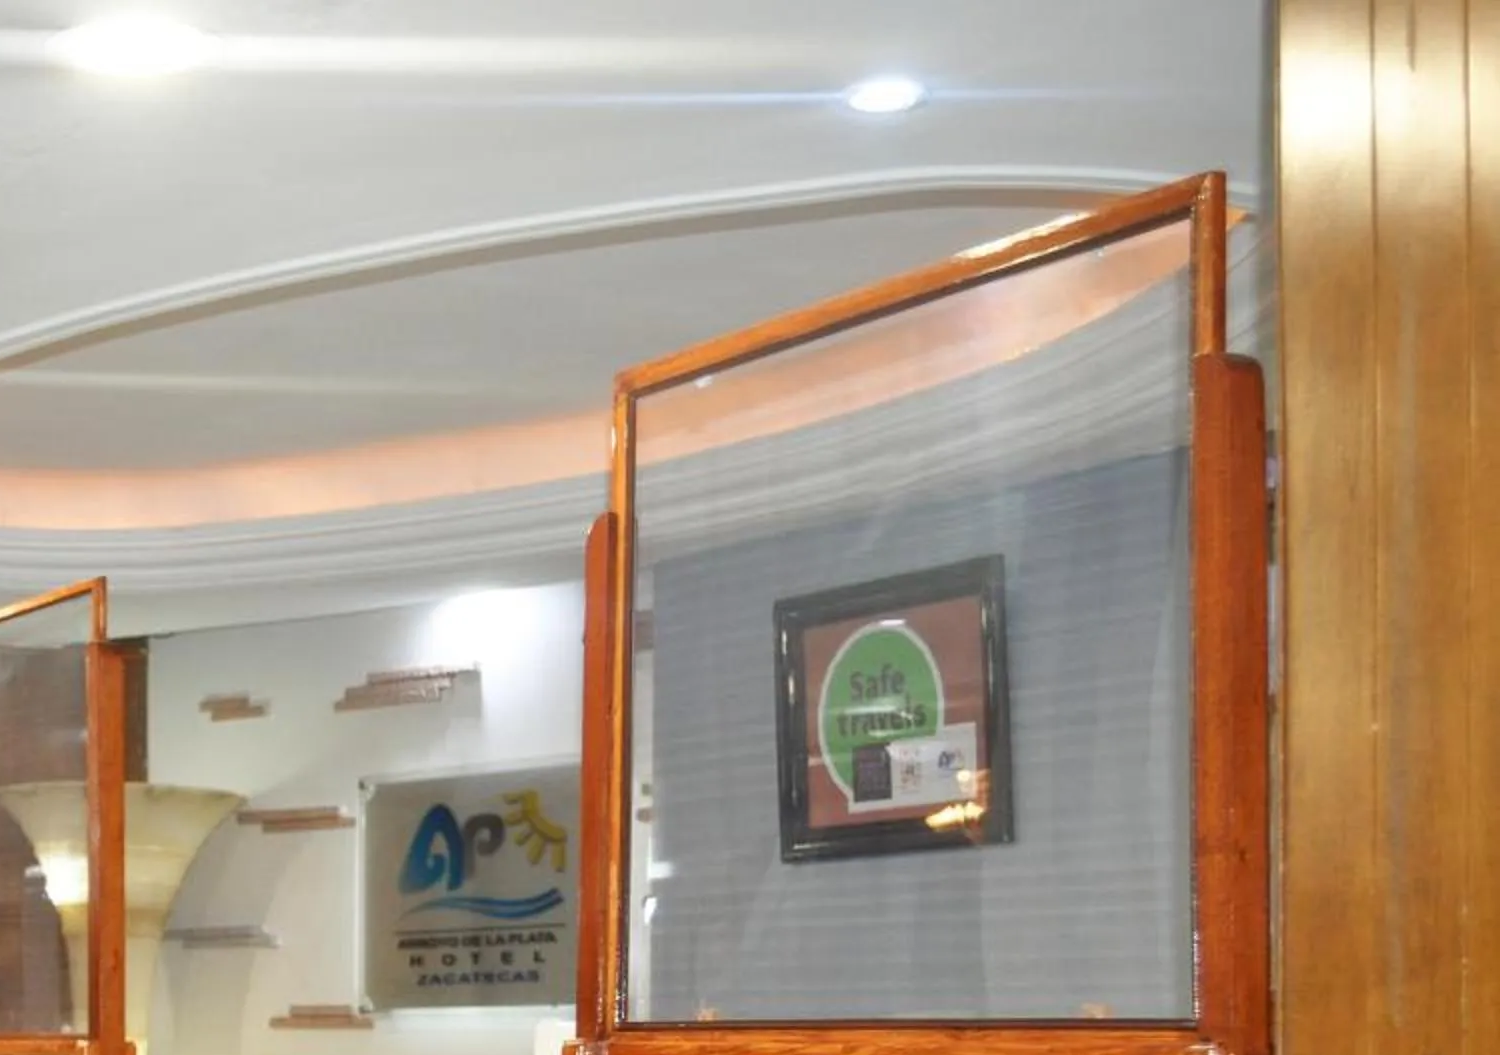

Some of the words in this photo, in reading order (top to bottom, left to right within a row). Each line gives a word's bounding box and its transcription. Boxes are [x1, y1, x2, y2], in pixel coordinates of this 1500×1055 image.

[849, 663, 905, 701] Safe
[836, 692, 928, 738] travels
[461, 935, 481, 948] DE
[485, 933, 506, 946] LA
[508, 930, 558, 944] PLATA
[408, 950, 546, 967] HOTEL
[416, 969, 540, 986] ZACATECAS
